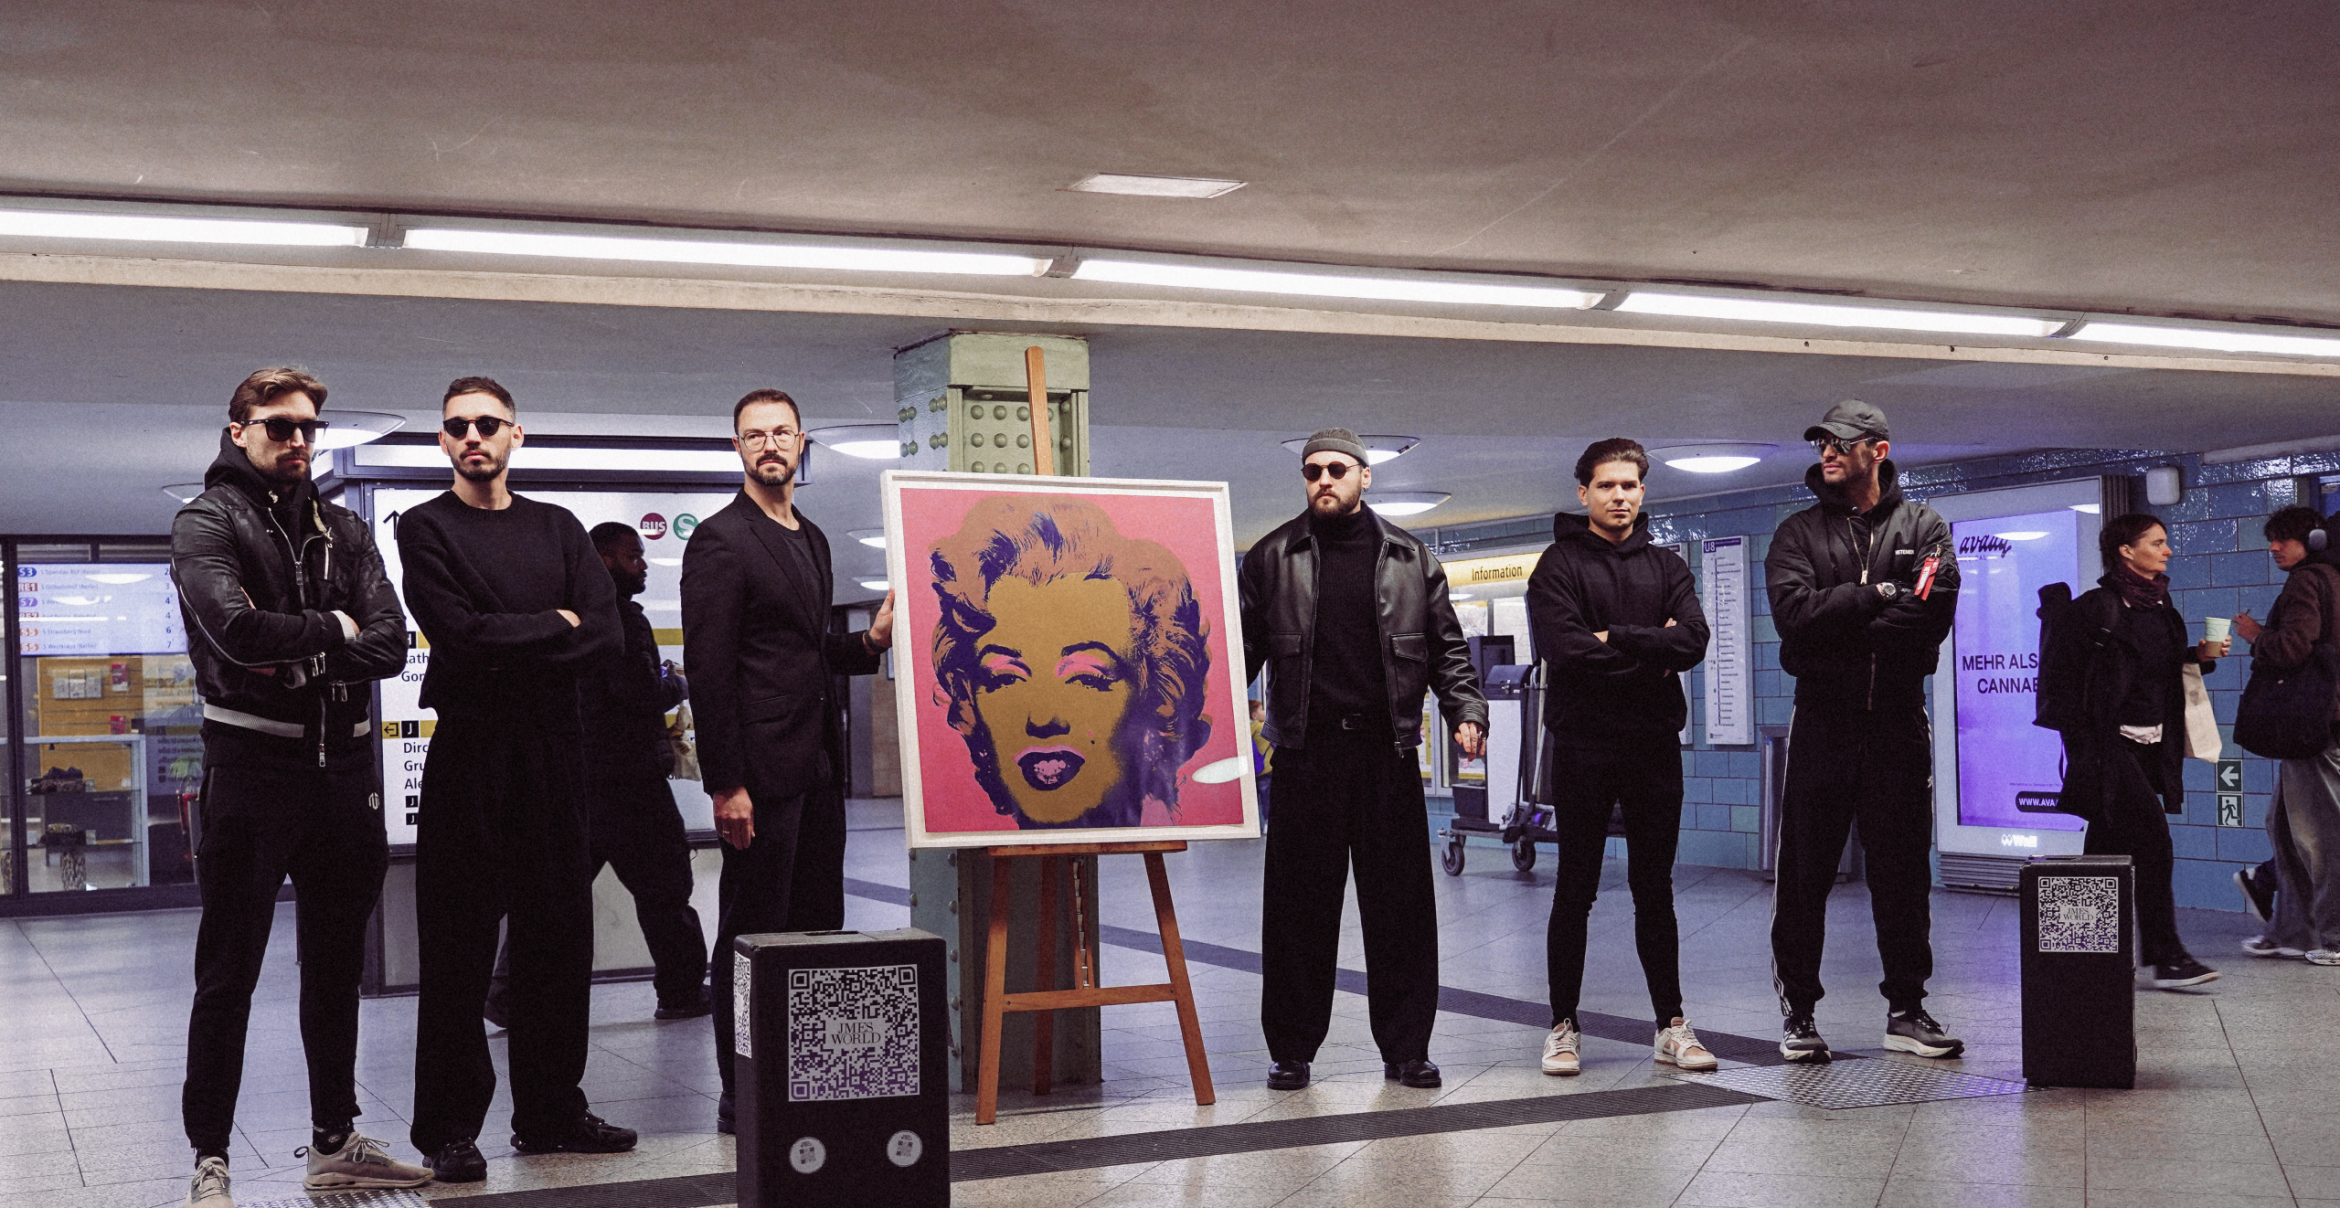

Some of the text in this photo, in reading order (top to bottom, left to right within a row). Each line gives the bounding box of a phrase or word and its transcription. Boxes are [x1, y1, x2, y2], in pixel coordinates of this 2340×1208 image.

[642, 521, 666, 533] BUS
[1704, 541, 1715, 552] U8
[19, 567, 34, 576] S3
[164, 567, 169, 576] 2
[1471, 564, 1523, 581] Information
[18, 582, 37, 592] RE1
[19, 598, 34, 607] S7
[406, 652, 429, 664] ath
[1962, 653, 2038, 671] MEHR ALS
[838, 1022, 874, 1034] JMES
[831, 1032, 881, 1045] WORLD
